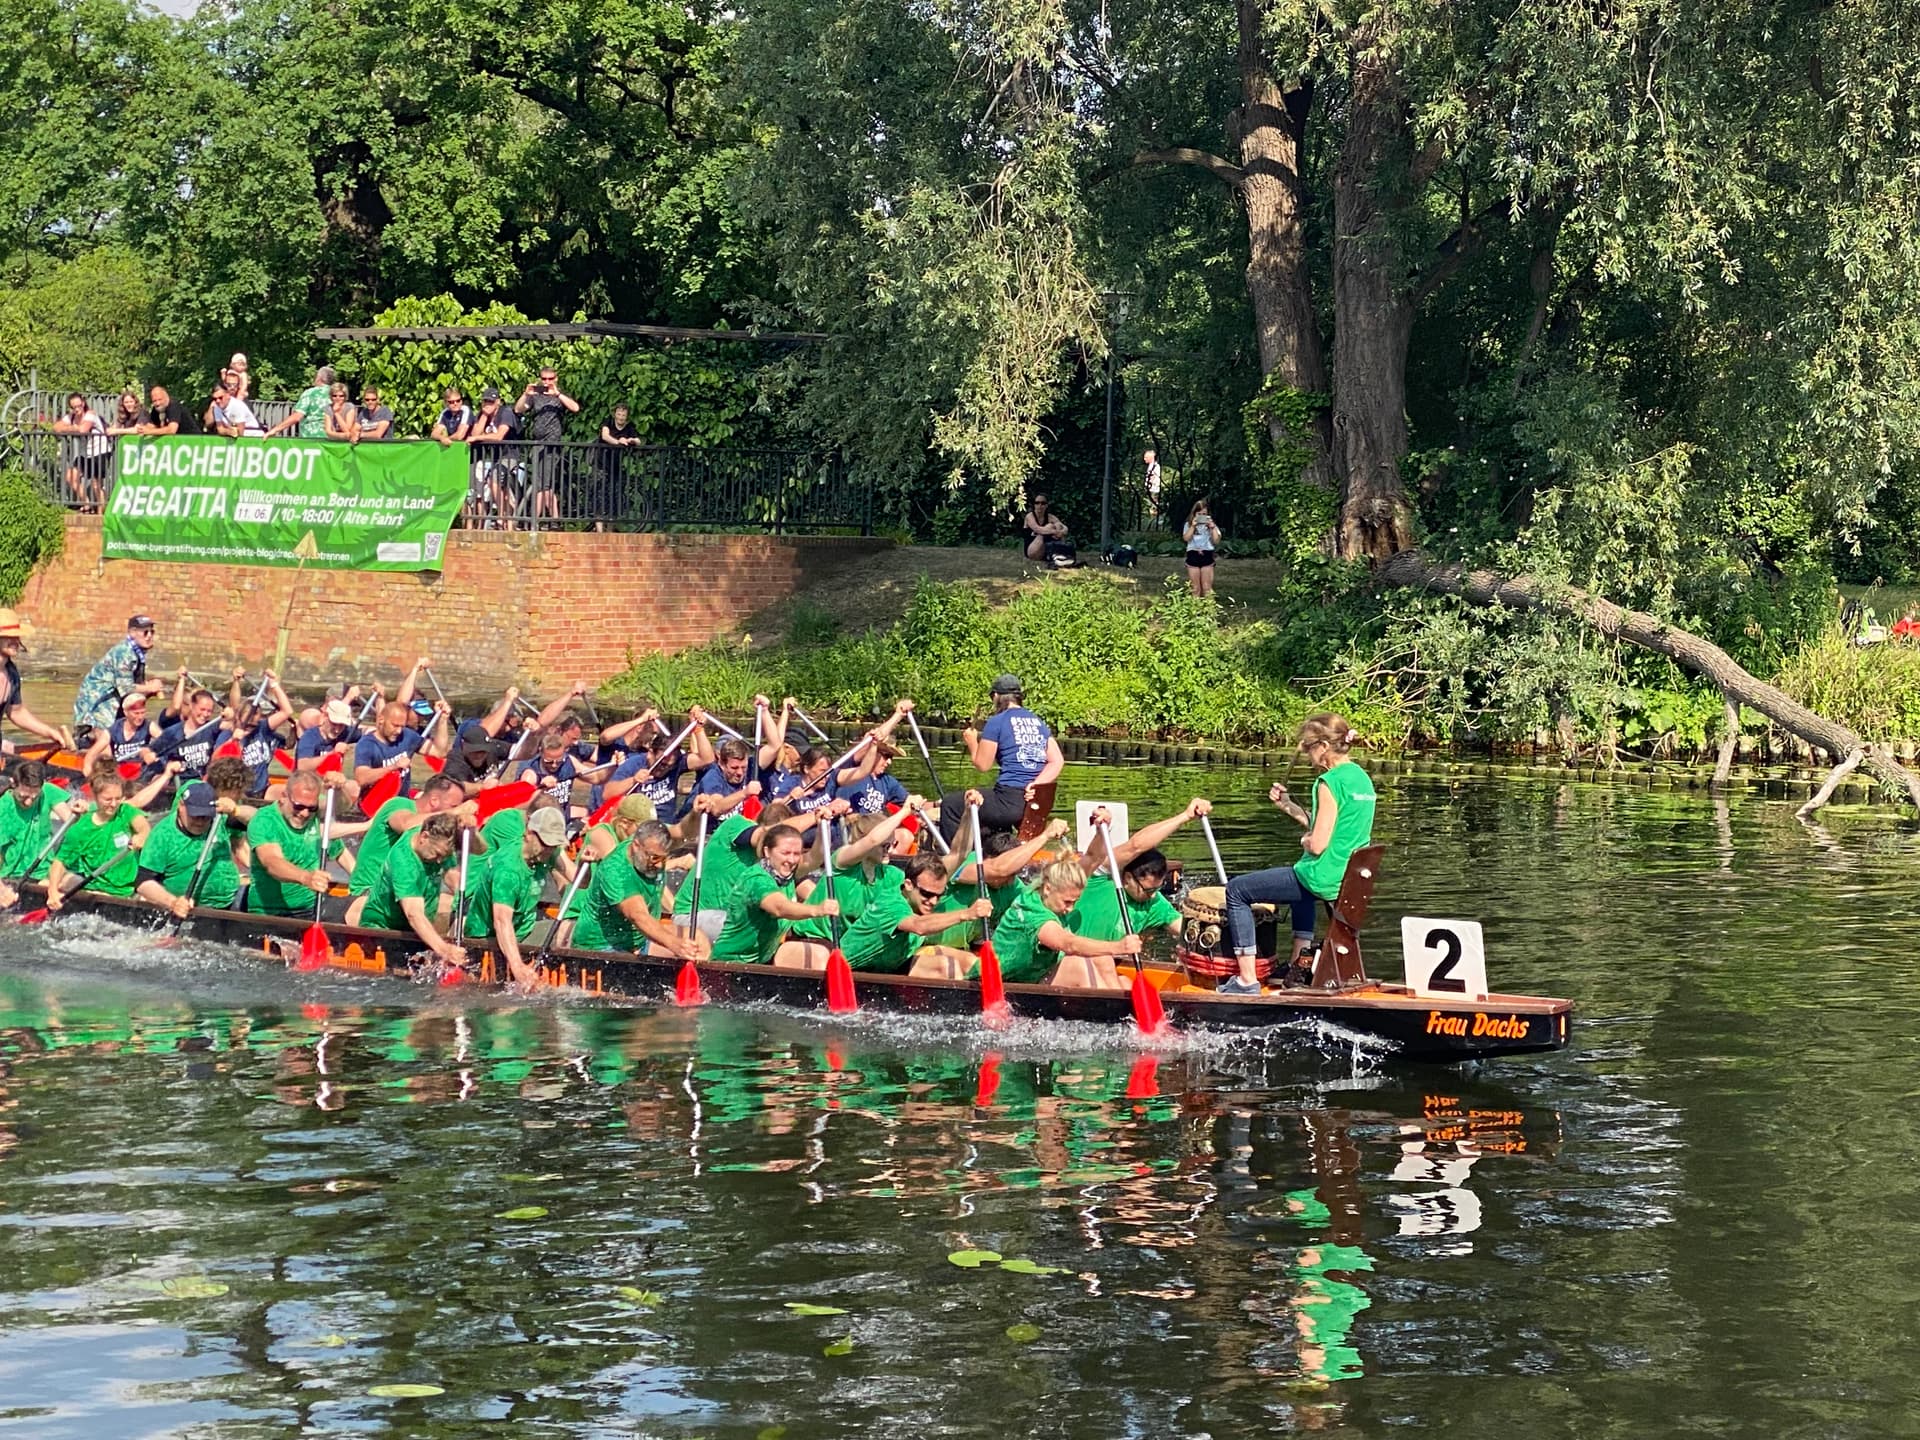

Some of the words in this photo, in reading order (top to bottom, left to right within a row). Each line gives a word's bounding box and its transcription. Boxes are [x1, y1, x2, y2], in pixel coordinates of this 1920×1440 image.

[122, 444, 322, 481] DRACHENBOOT
[111, 485, 227, 519] REGATTA
[239, 489, 308, 506] Willkommen
[310, 495, 325, 507] an
[328, 493, 359, 508] Bord
[360, 495, 384, 509] und
[386, 497, 401, 510] an
[403, 494, 435, 510] Land
[343, 510, 370, 525] Alte
[369, 511, 405, 527] Fahrt
[1424, 928, 1467, 994] 2
[1426, 1010, 1469, 1037] Frau
[1471, 1012, 1531, 1040] Dachs
